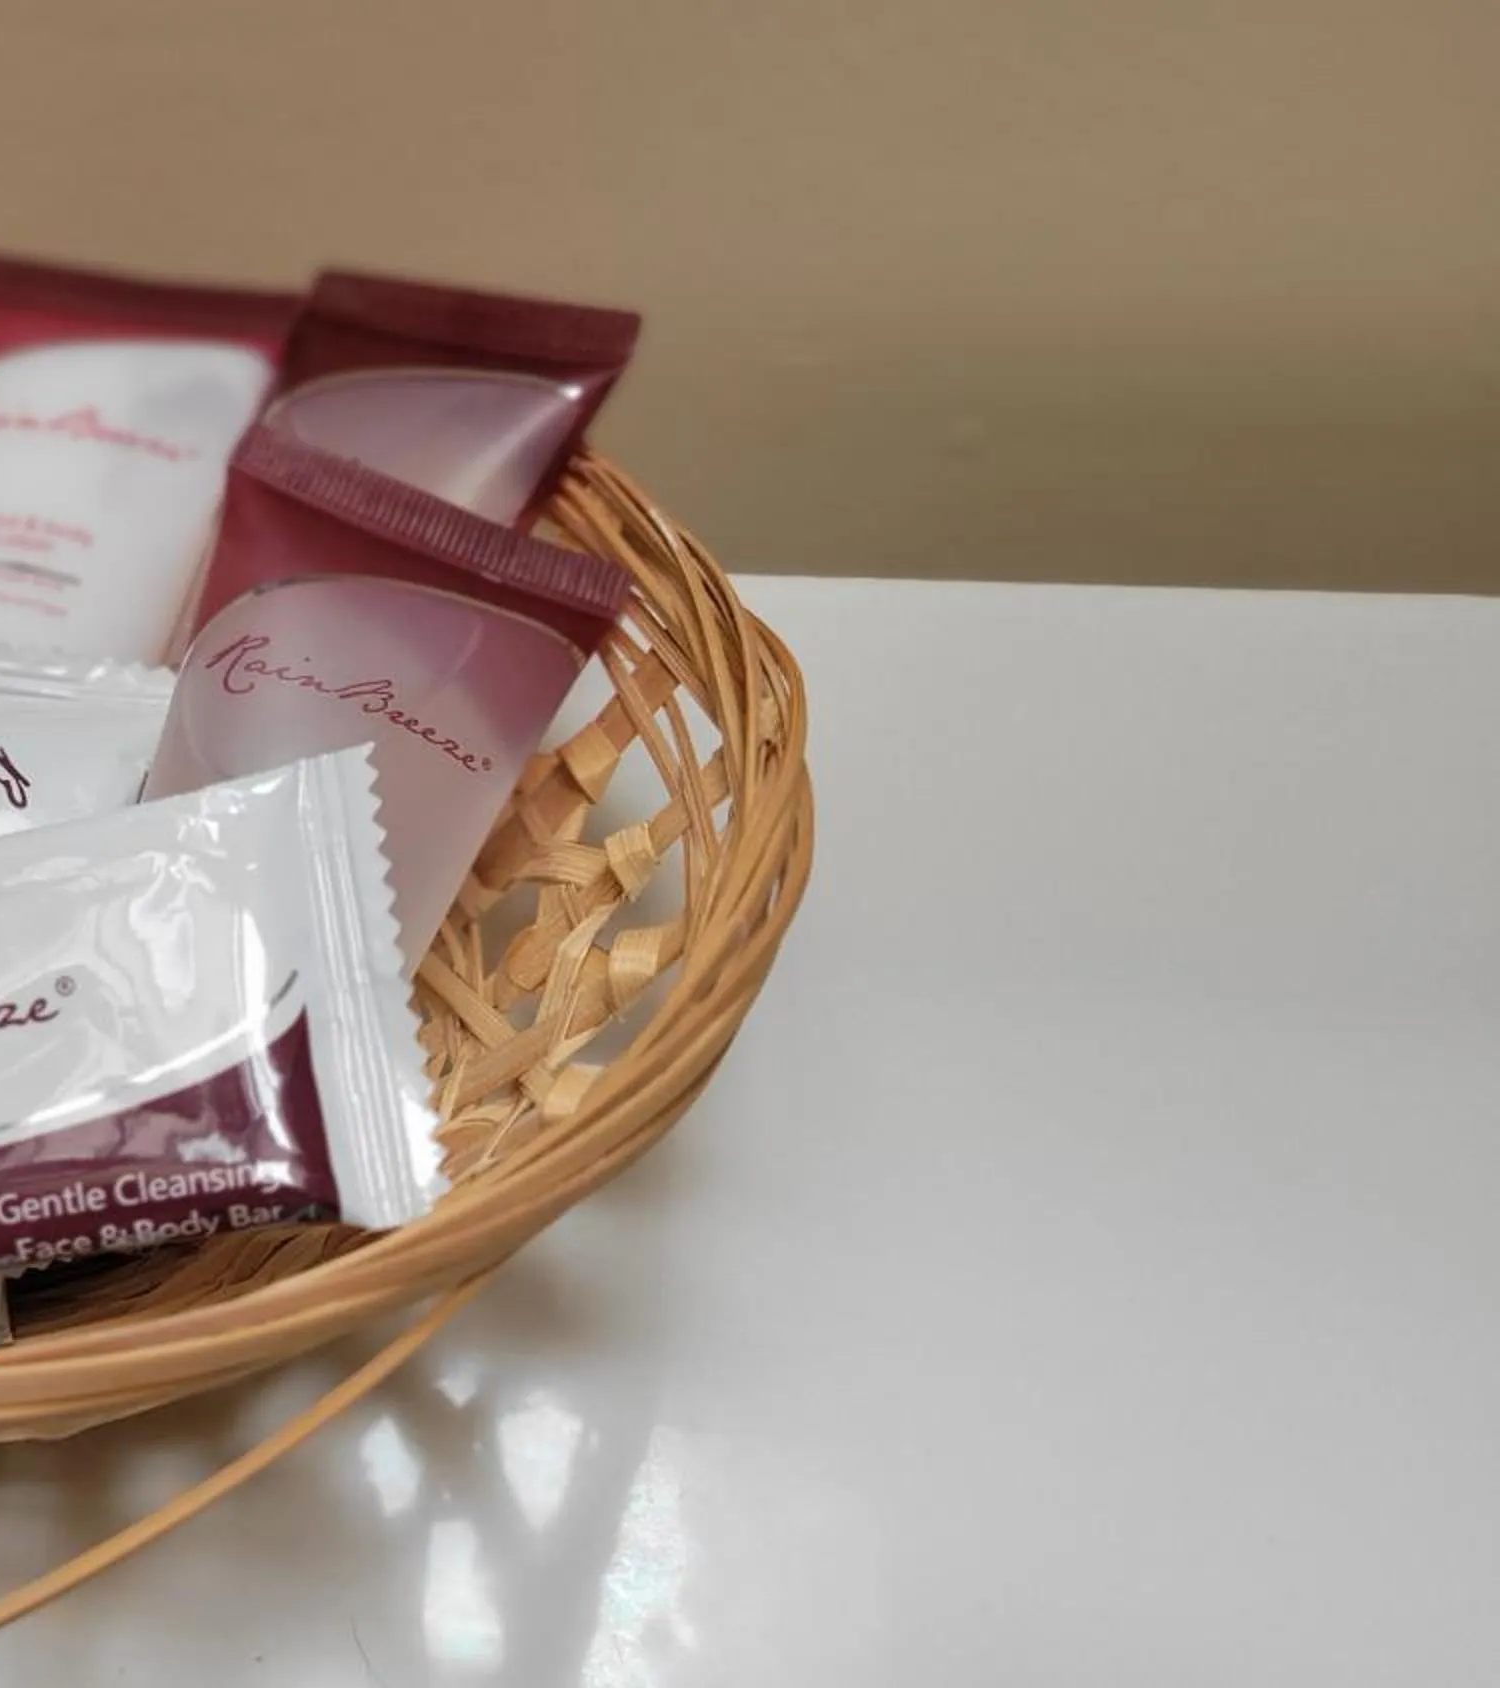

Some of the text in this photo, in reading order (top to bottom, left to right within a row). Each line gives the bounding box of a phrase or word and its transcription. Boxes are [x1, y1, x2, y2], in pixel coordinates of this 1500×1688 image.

[14, 1203, 284, 1261] Face & Body Bar
